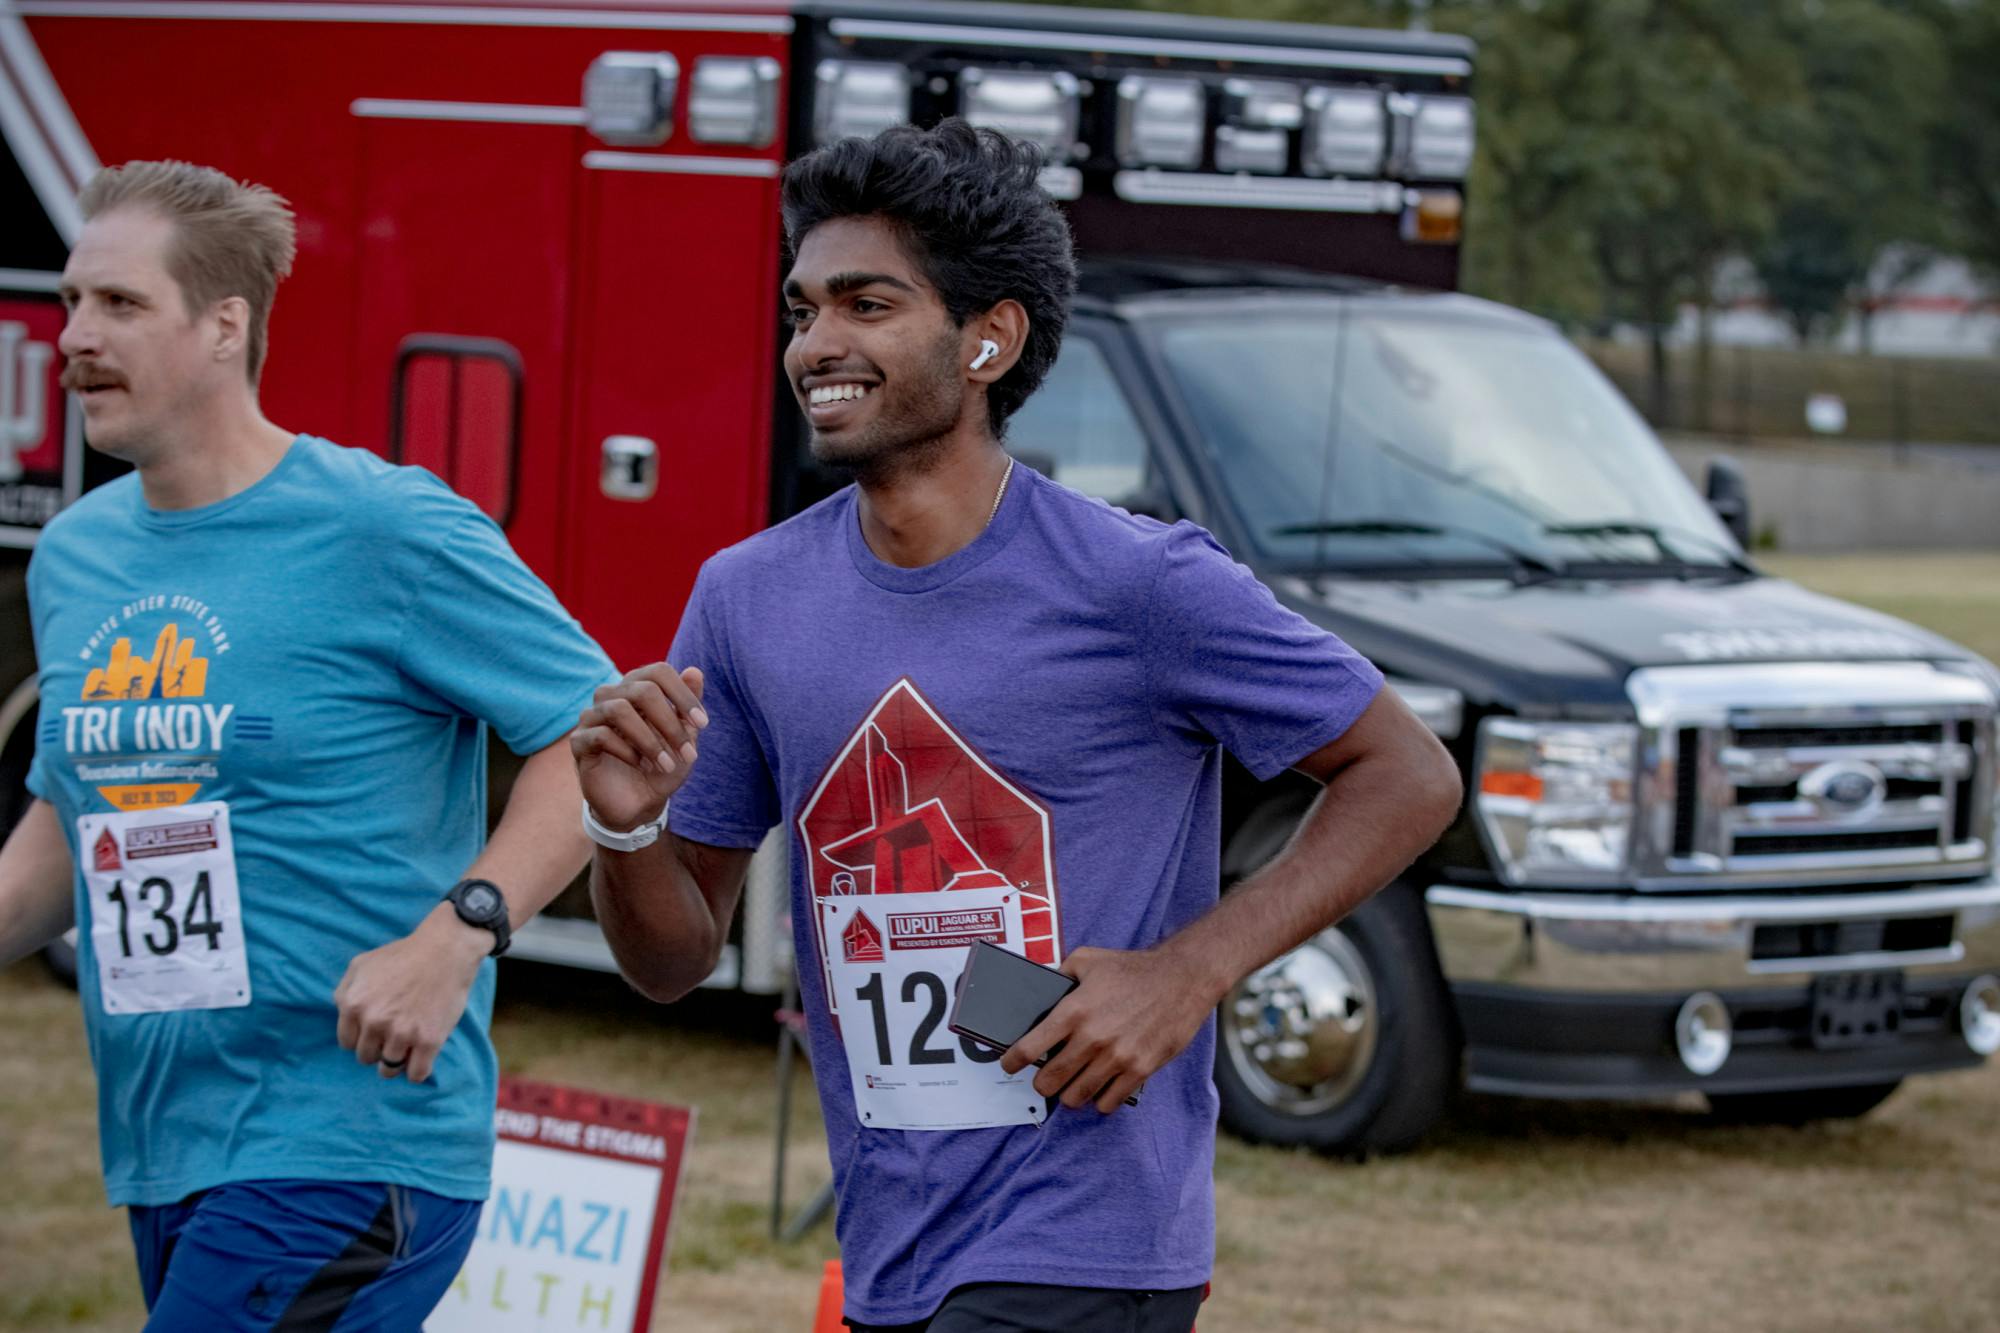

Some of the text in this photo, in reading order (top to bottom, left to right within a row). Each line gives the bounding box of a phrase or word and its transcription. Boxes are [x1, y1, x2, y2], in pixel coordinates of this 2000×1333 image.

[170, 595, 210, 620] STATE
[204, 615, 231, 655] PARK
[61, 703, 235, 753] TRI INDY
[107, 870, 224, 958] 134
[895, 913, 994, 935] IUPUI JAGUAR 5K
[540, 1117, 582, 1146] THE
[585, 1125, 665, 1162] STIGMA
[488, 1185, 629, 1266] NAZI
